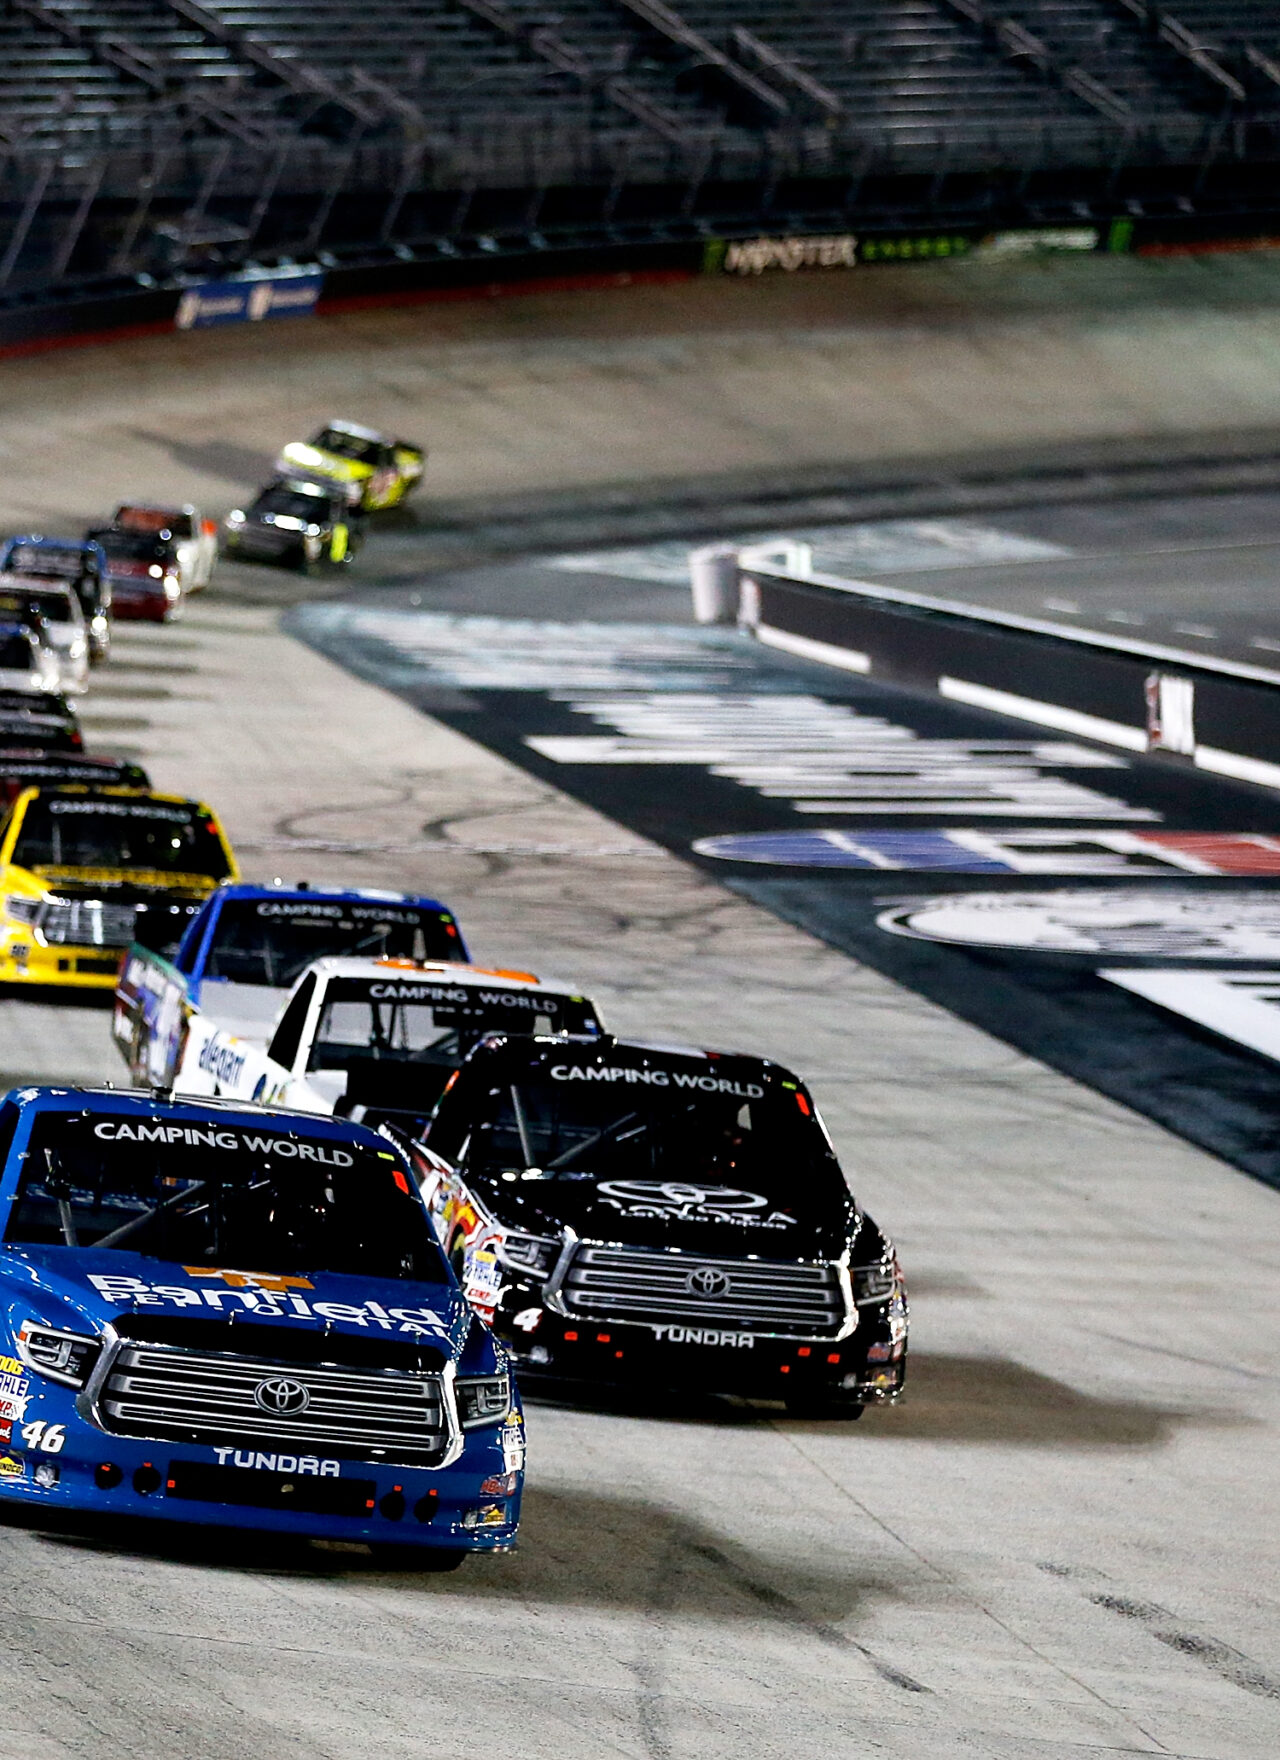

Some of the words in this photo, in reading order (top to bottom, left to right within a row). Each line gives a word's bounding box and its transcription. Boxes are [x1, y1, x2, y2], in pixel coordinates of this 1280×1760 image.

[257, 903, 343, 919] CAMPING
[351, 908, 420, 925] WORLD
[370, 983, 469, 1003] CAMPING
[479, 991, 558, 1013] WORLD
[550, 1065, 670, 1086] CAMPING
[671, 1073, 764, 1099] WORLD
[94, 1122, 239, 1150] CAMPING
[242, 1134, 354, 1167] WORLD
[86, 1274, 449, 1328] Banfield
[513, 1307, 543, 1332] 4
[651, 1325, 754, 1349] TUNDRA
[21, 1420, 67, 1453] 46
[213, 1447, 340, 1477] TUNDRA
